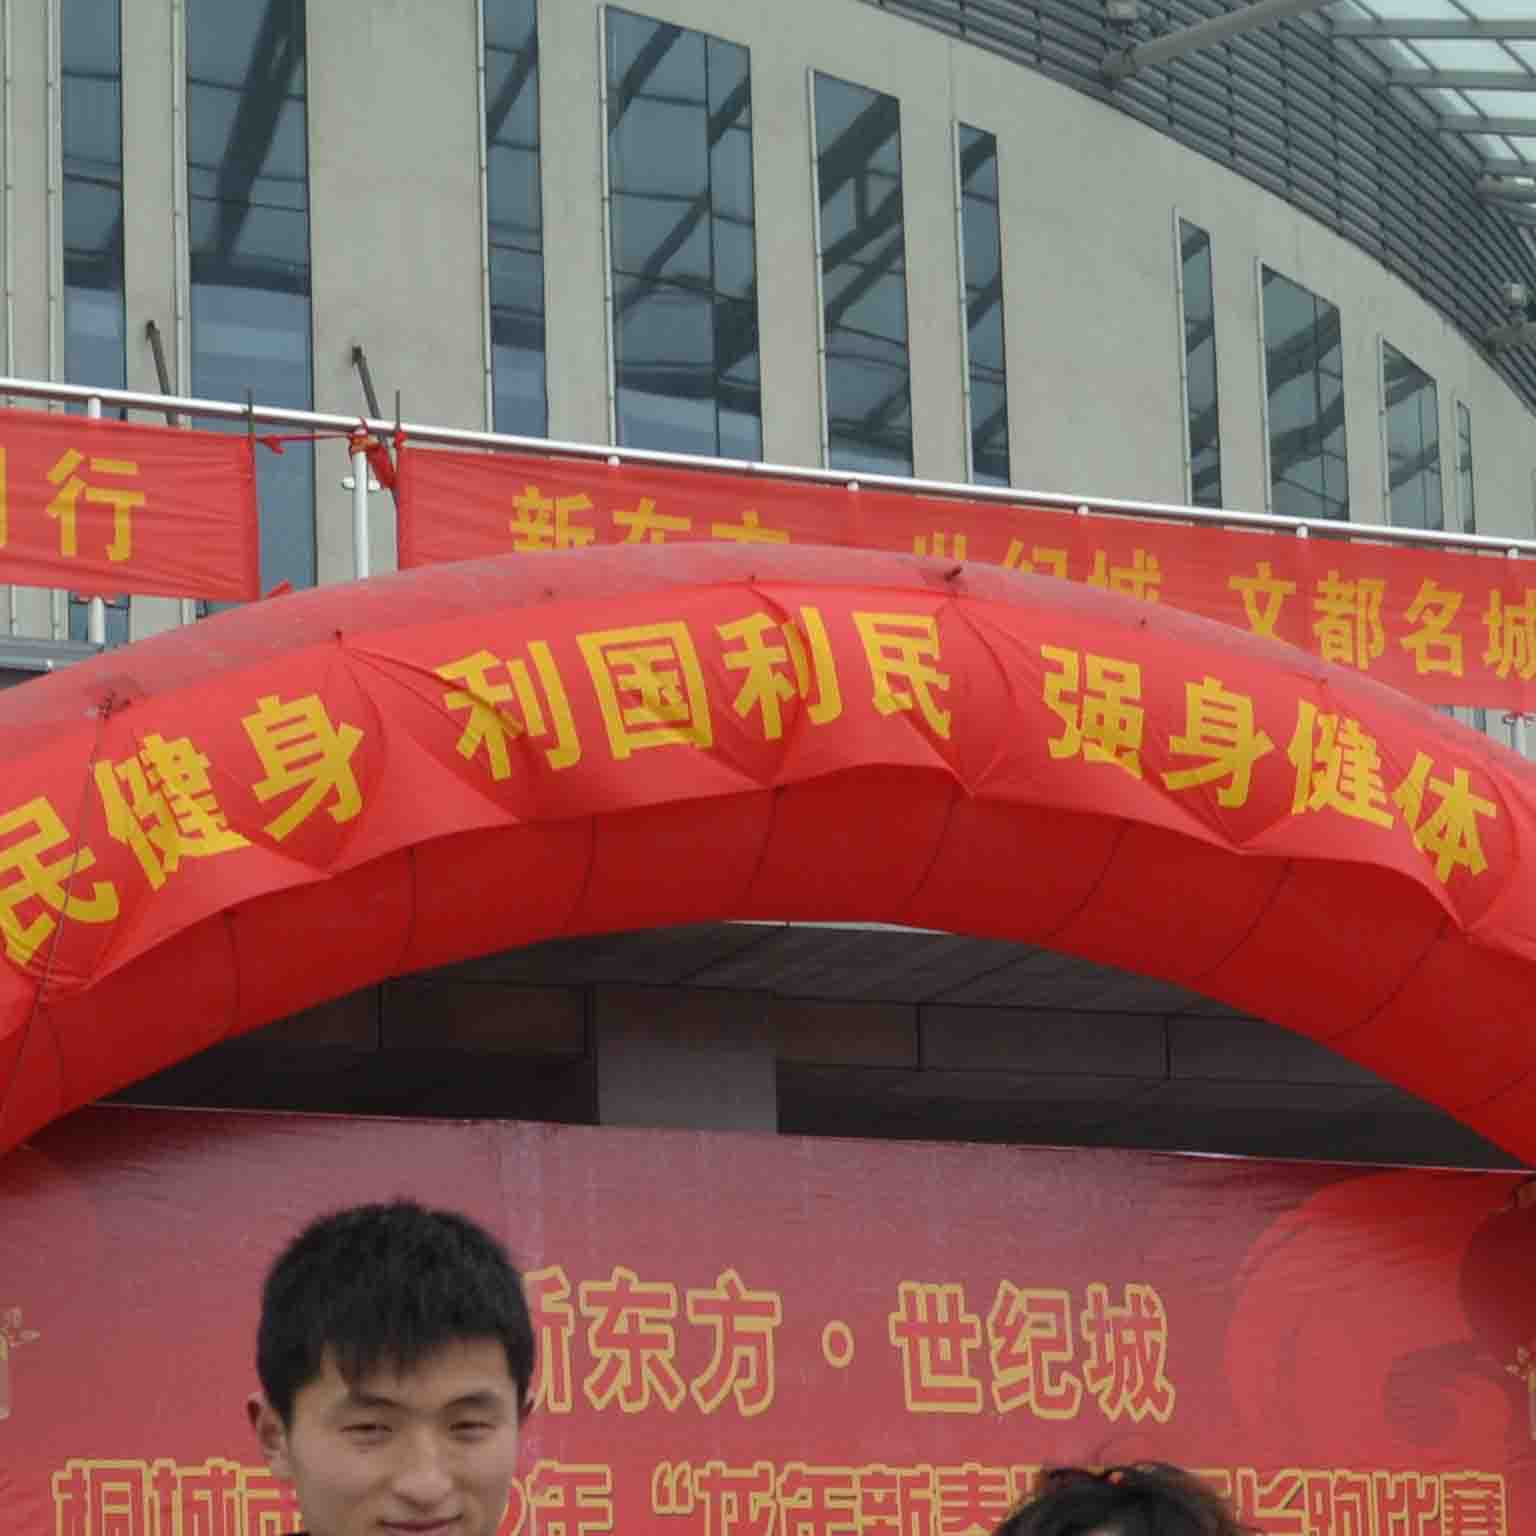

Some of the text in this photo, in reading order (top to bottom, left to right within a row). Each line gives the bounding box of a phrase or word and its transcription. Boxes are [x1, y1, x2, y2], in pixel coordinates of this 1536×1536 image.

[432, 606, 952, 781] 利国利民
[1040, 644, 1498, 883] 强身健体
